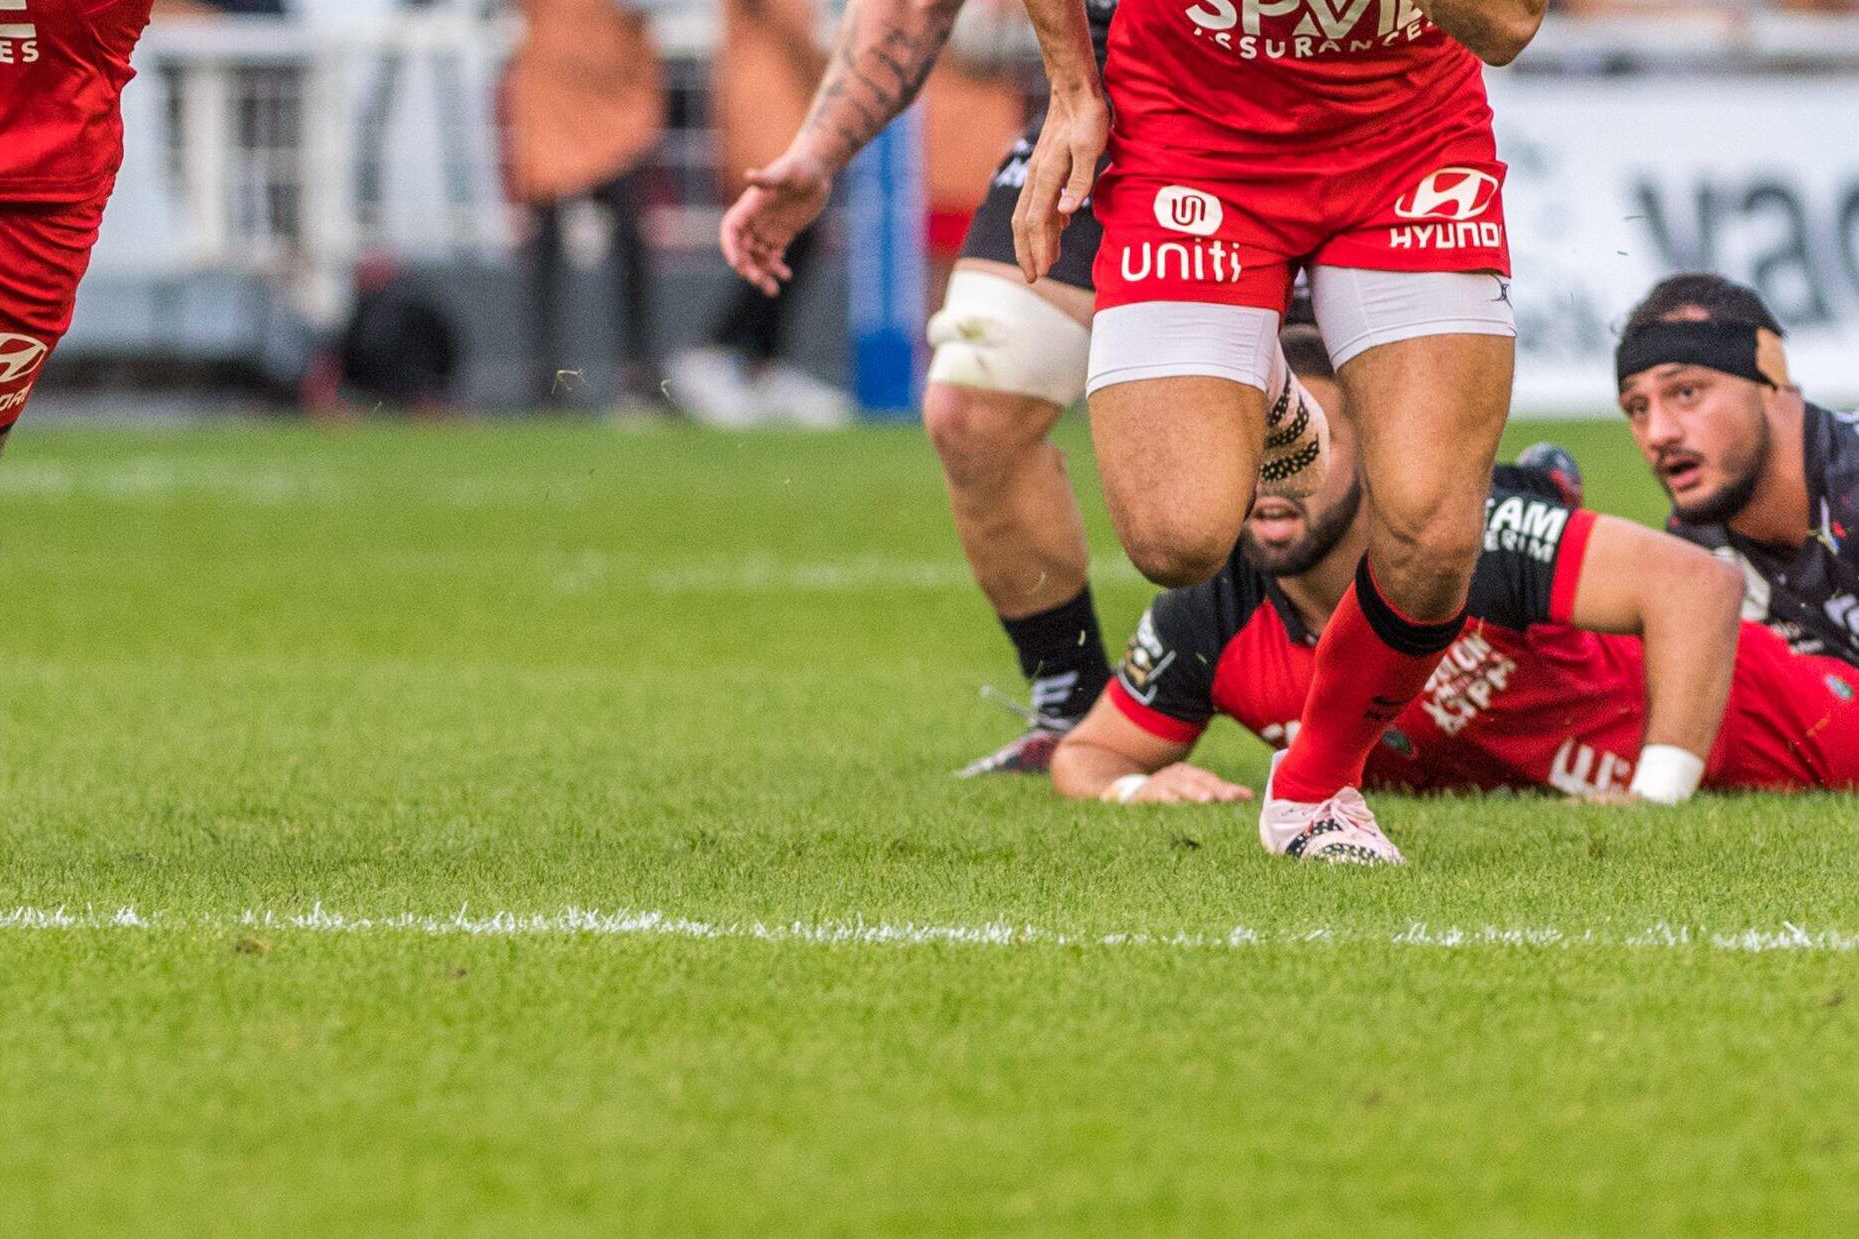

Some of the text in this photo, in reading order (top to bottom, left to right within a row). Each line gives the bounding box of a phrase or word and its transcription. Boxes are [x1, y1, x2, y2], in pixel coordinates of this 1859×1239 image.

[1389, 221, 1503, 249] HYUND
[1121, 237, 1242, 282] uniti
[1484, 494, 1569, 544] AM
